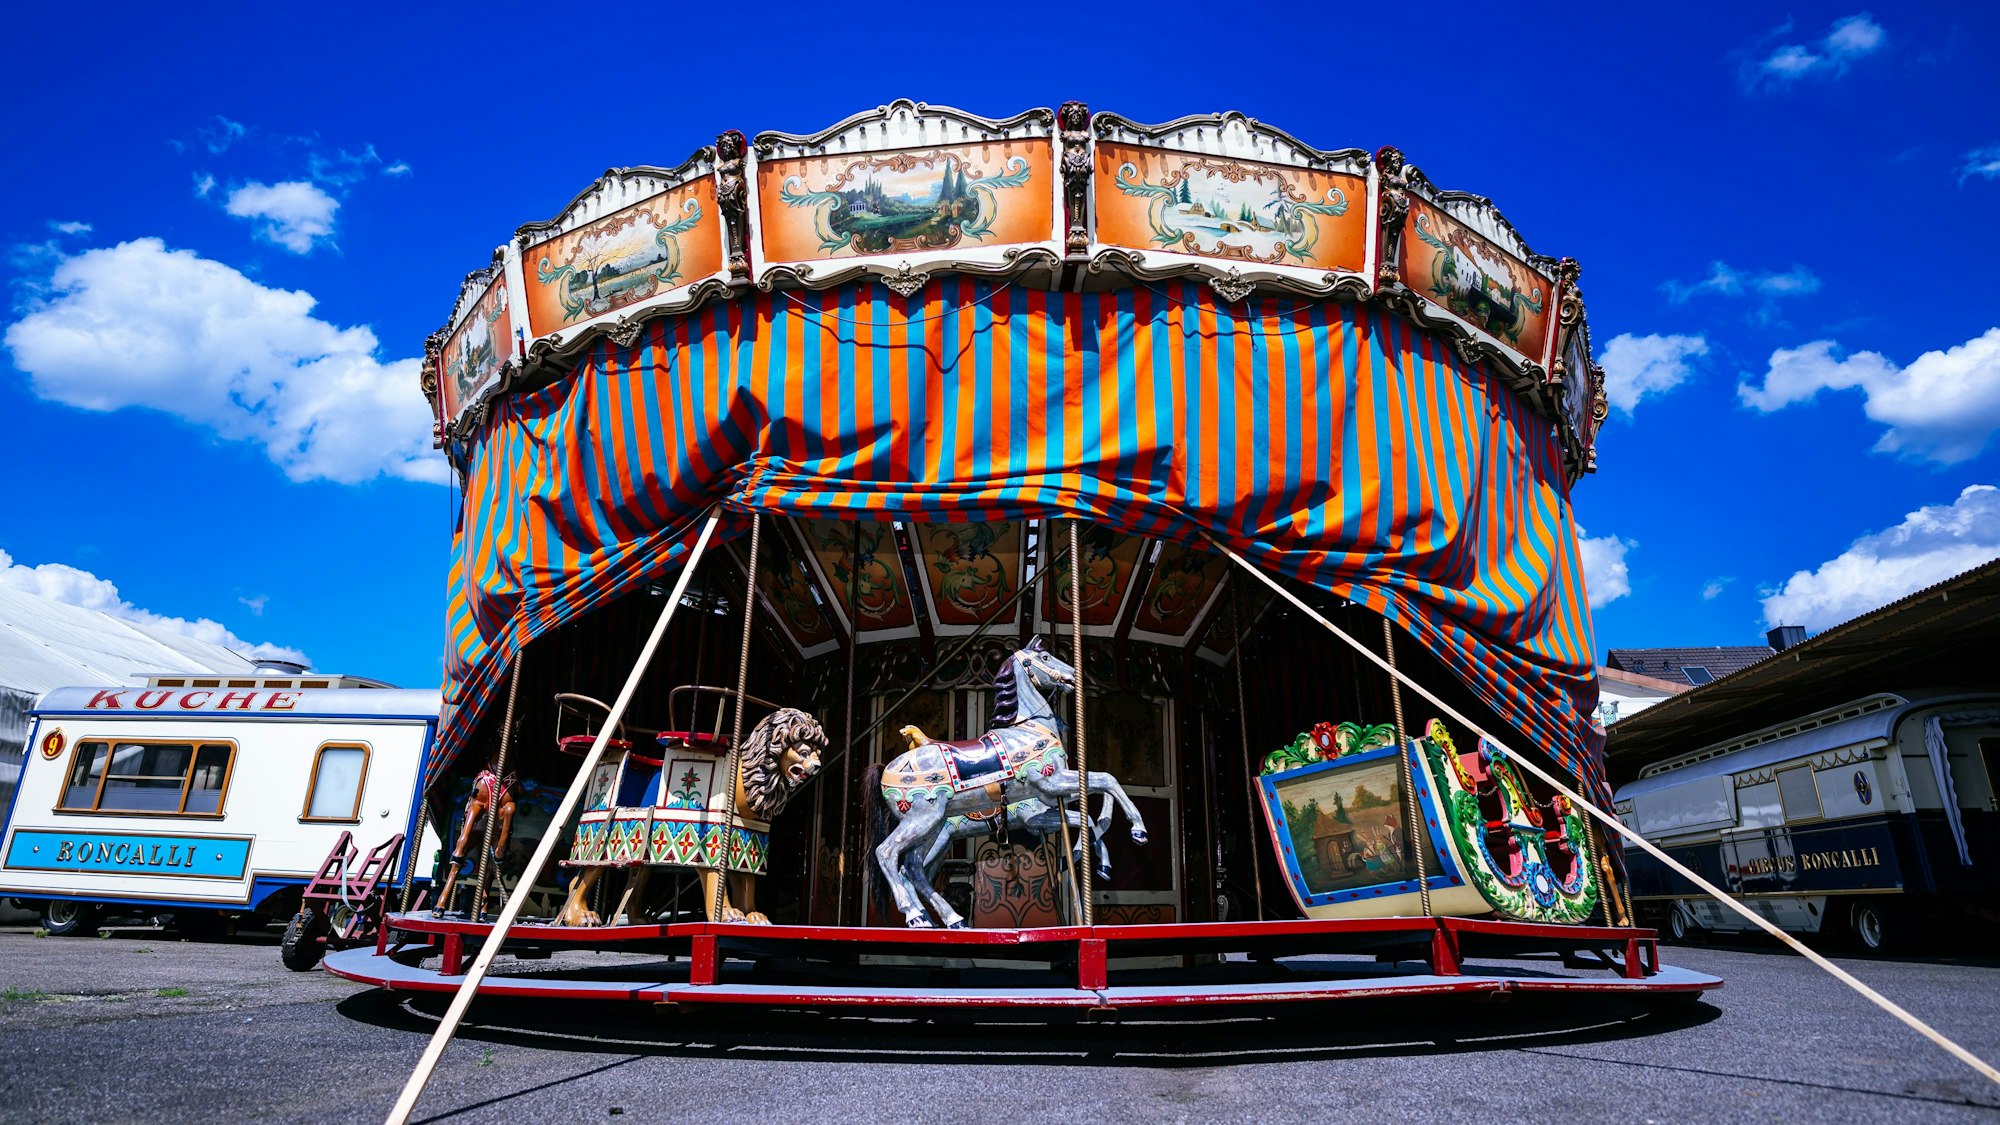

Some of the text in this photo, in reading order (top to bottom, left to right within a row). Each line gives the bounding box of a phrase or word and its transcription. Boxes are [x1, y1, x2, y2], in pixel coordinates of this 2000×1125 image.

[84, 690, 303, 711] KÜCHE
[47, 737, 59, 755] 9
[56, 840, 197, 867] RONCALLI
[1748, 847, 1881, 874] CIRCUS RONCALLI
